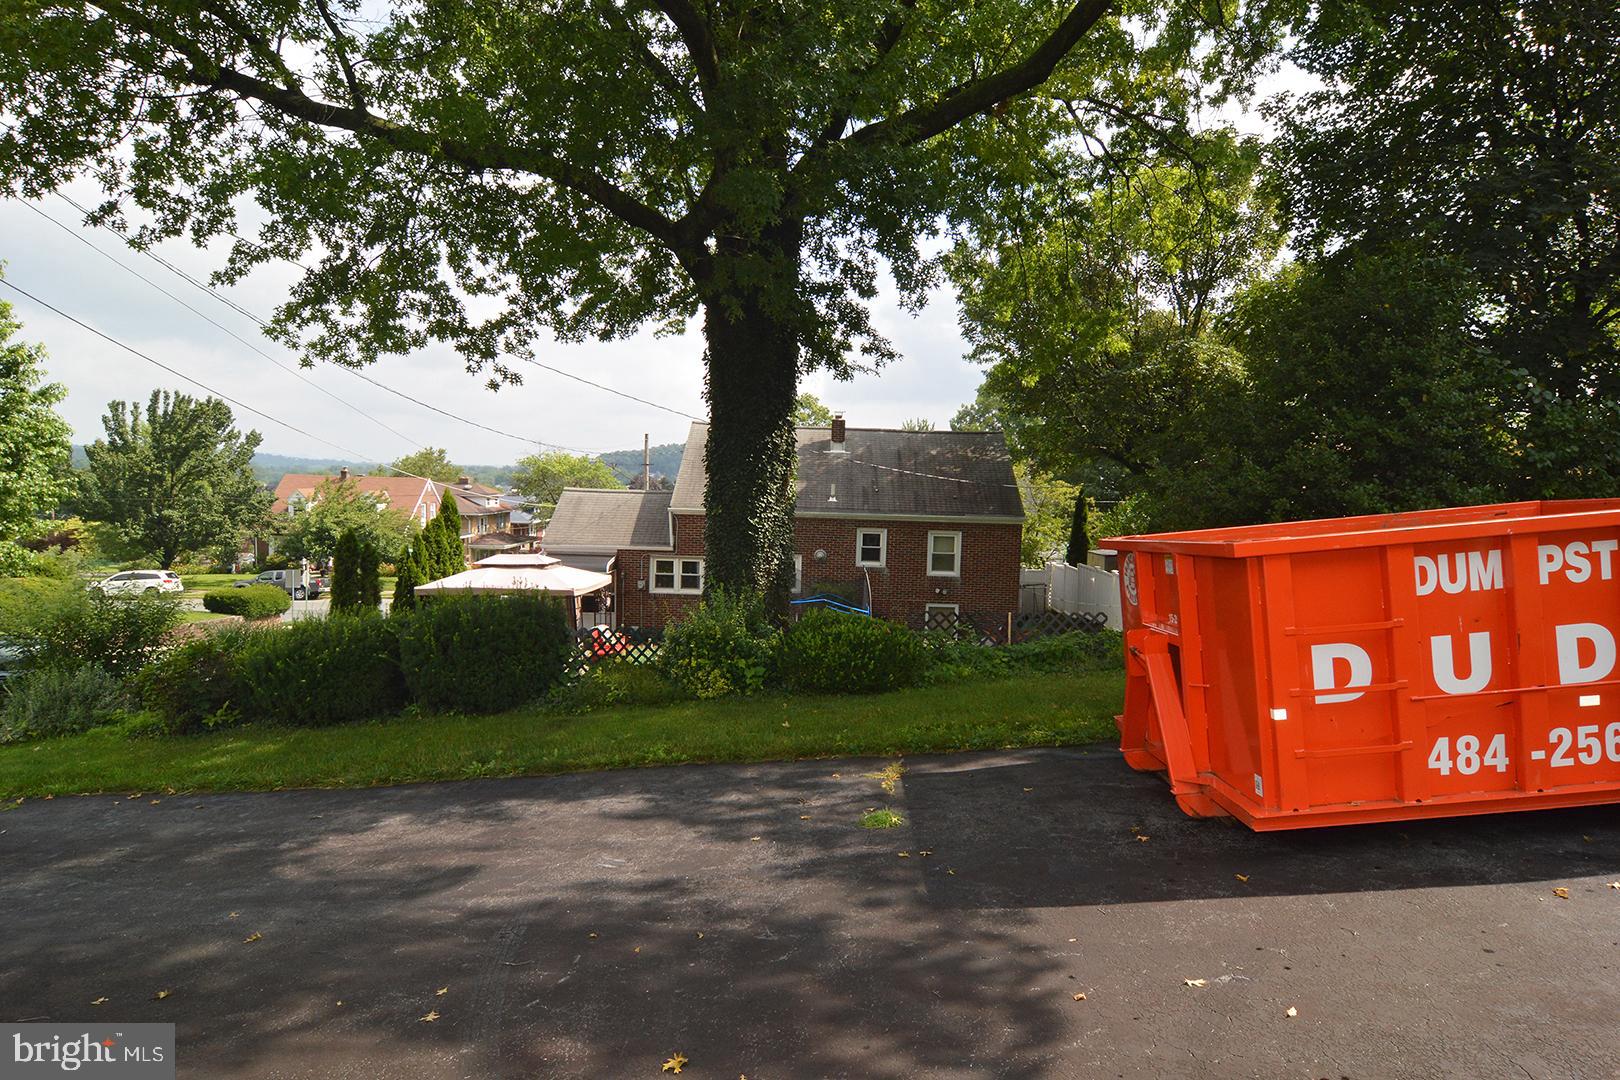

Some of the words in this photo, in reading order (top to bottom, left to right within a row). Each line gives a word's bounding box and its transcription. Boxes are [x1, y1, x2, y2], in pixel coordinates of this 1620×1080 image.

[1414, 549, 1504, 596] DUM
[1537, 539, 1618, 585] PST
[1427, 733, 1510, 776] 484
